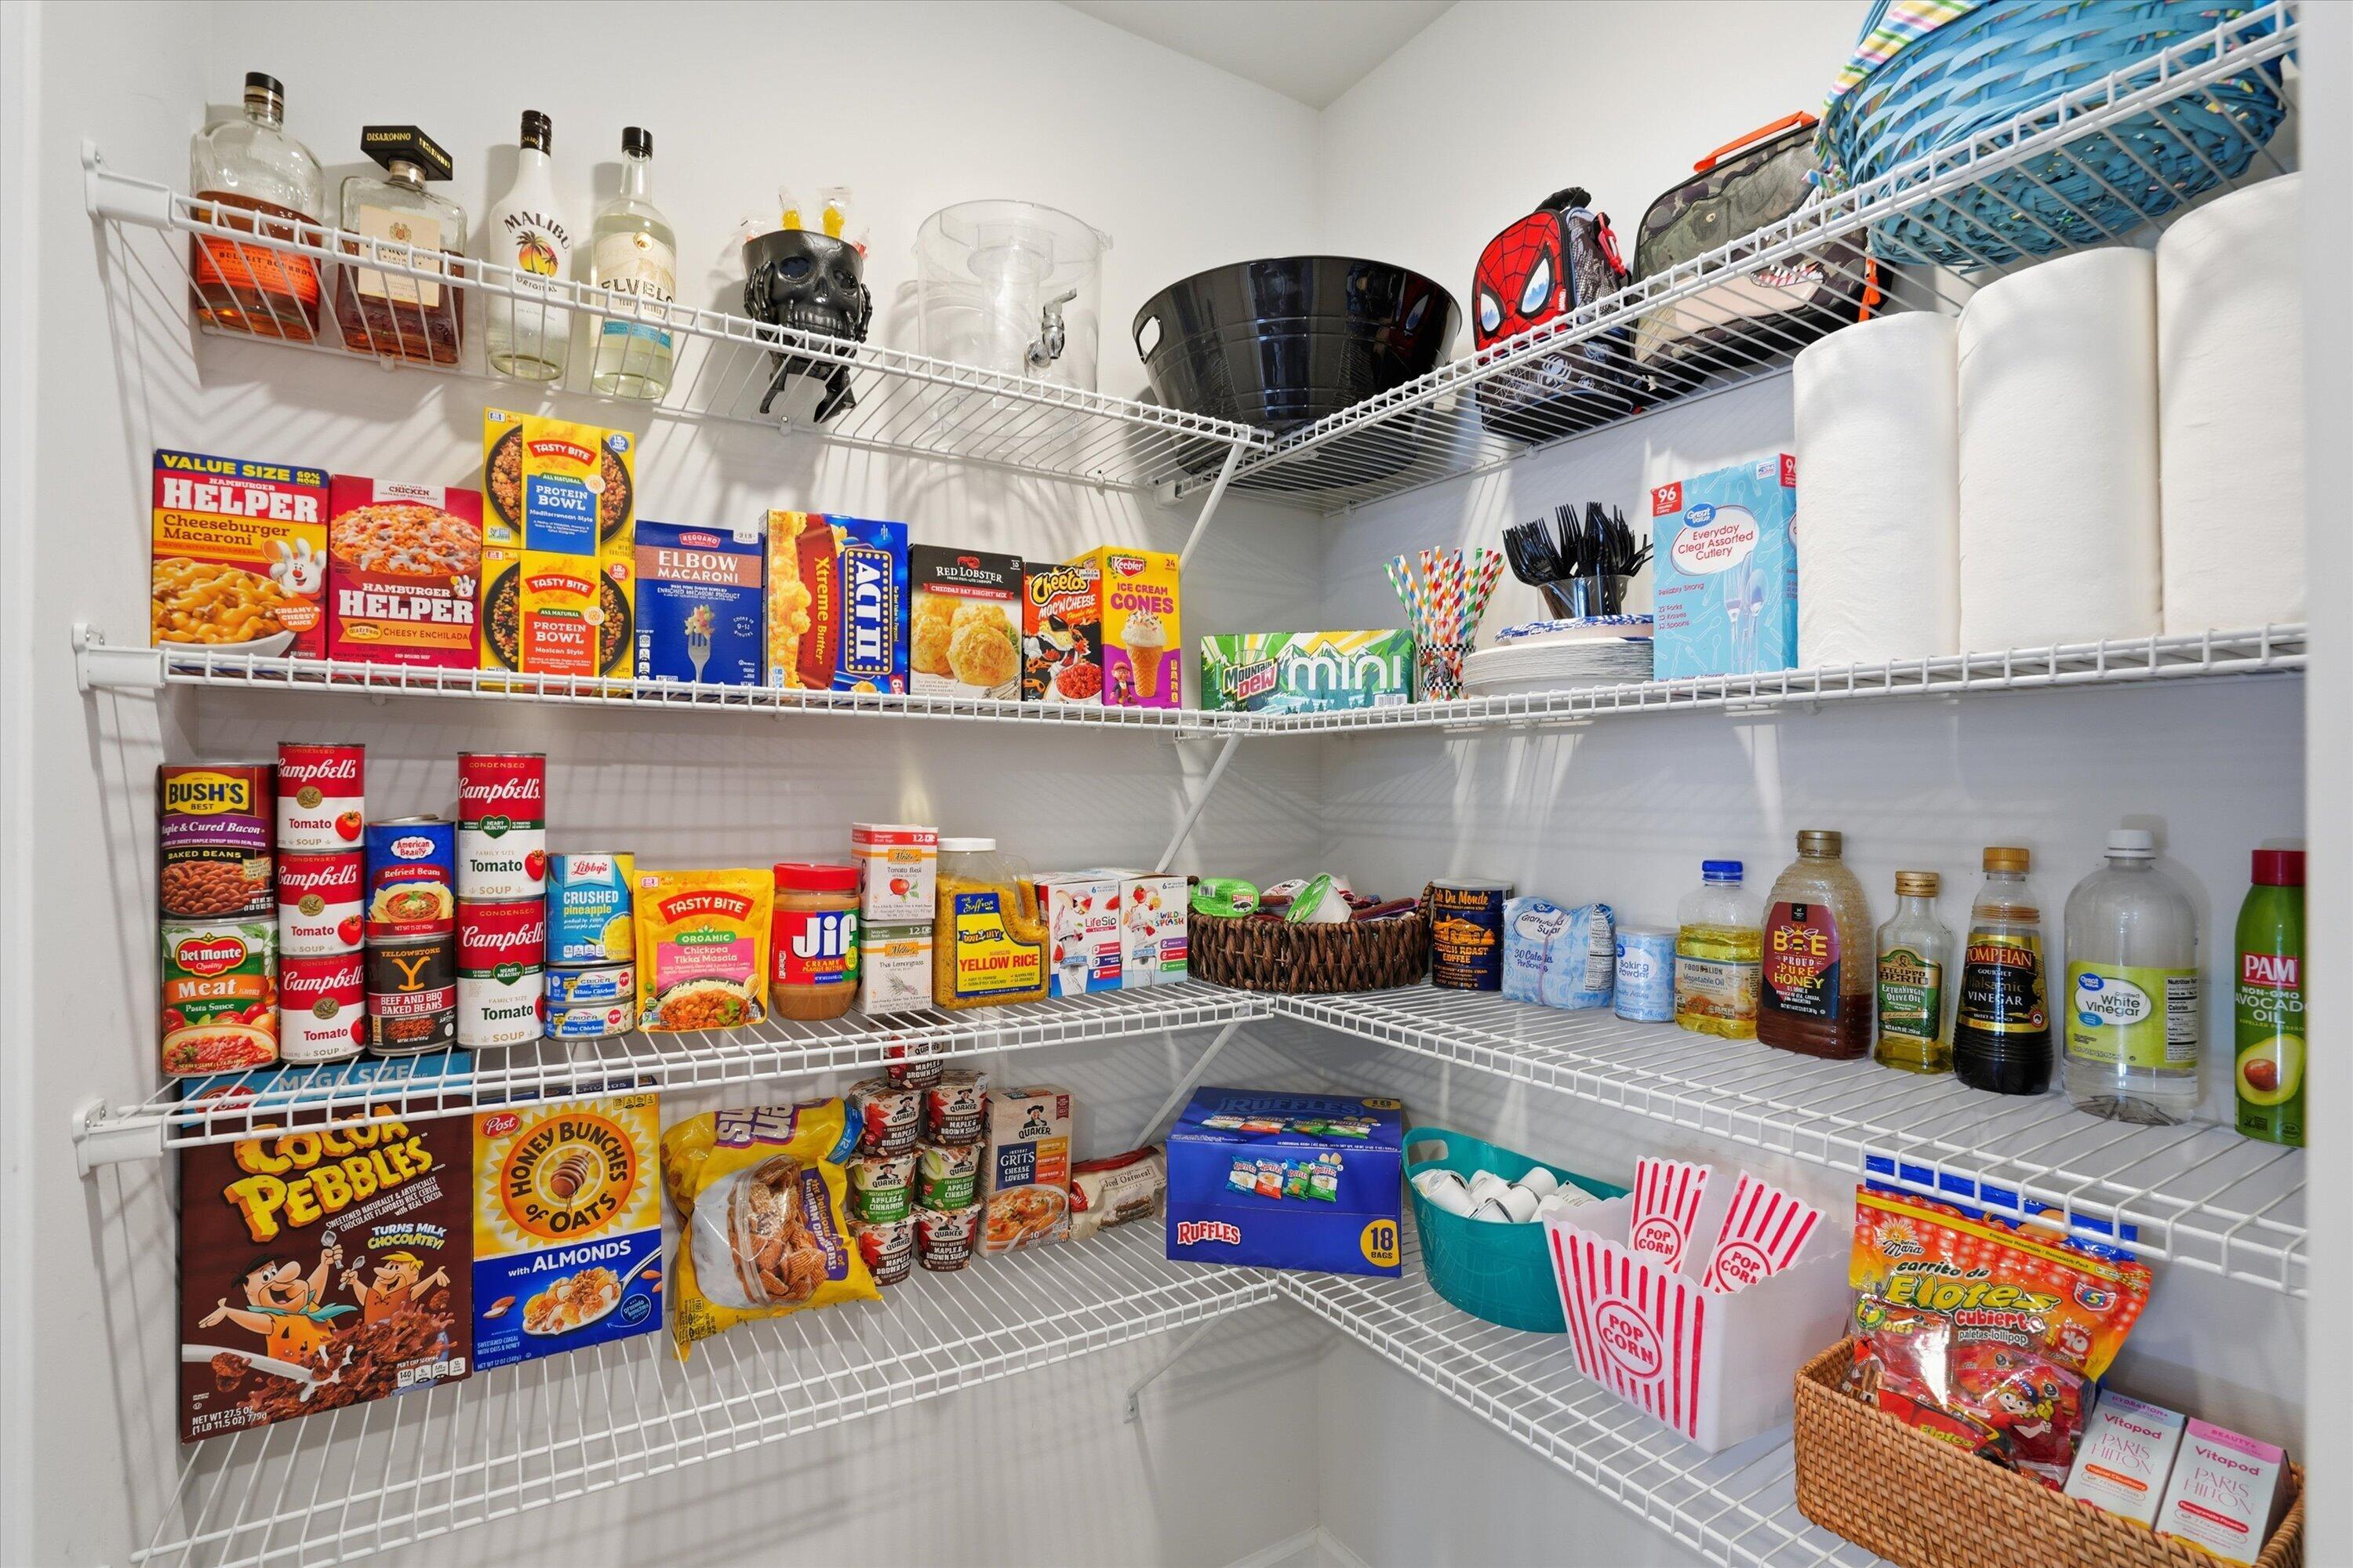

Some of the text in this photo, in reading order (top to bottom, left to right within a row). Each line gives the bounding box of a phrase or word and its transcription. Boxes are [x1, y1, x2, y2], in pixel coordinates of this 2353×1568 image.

[366, 133, 411, 142] DISARONNO
[504, 210, 571, 250] MALIBU
[533, 444, 591, 460] TASTY BITE
[162, 454, 290, 481] VALUE SIZE
[209, 477, 275, 492] HAMBURGER
[162, 477, 318, 522] HELPER
[536, 486, 588, 500] PROTEIN
[1657, 488, 1676, 502] 96
[538, 495, 586, 511] BOWL
[163, 515, 290, 538] Cheeseburger
[1693, 523, 1740, 540] Everyday
[163, 527, 253, 546] Macaroni
[1678, 531, 1754, 555] Clear Assorted
[659, 550, 738, 572] ELBOW
[1696, 547, 1733, 562] Cutlery
[1112, 558, 1144, 573] Keebler
[657, 567, 739, 584] MACARONI
[936, 566, 958, 577] RED
[958, 566, 1004, 584] LOBSTER
[362, 583, 451, 598] HAMBURGER
[532, 578, 590, 593] TASTY BITE
[814, 555, 830, 621] Xtreme
[856, 561, 882, 622] ACT
[1031, 569, 1088, 605] Cheetos
[1117, 582, 1168, 595] ICE CREAM
[338, 590, 474, 624] HELPER
[1111, 593, 1174, 614] CONES
[533, 621, 587, 632] PROTEIN
[384, 628, 416, 638] CHEESY
[420, 630, 468, 641] ENCHILADA
[536, 631, 584, 644] BOWL
[1288, 655, 1401, 690] mini
[278, 759, 356, 782] Campbell's
[169, 784, 244, 805] BUSH'S
[459, 778, 540, 804] Campbell's
[189, 821, 260, 835] Cured Bacon
[289, 818, 332, 829] Tomato
[396, 840, 430, 849] American
[168, 850, 198, 860] BAKED
[470, 859, 522, 872] Tomato
[571, 860, 607, 875] Libby's
[278, 864, 357, 891] Campbell's
[384, 868, 440, 879] Refried Beans
[479, 886, 511, 895] SOUP
[563, 890, 619, 904] CRUSHED
[1459, 890, 1489, 905] Monde
[564, 904, 612, 917] pineapple
[667, 897, 747, 915] TASTY BITE
[291, 926, 335, 937] Tomato
[682, 933, 730, 943] ORGANIC
[792, 912, 857, 958] Jif
[180, 948, 242, 962] Del Monte
[381, 947, 441, 958] YELLOWSTONE
[683, 945, 728, 955] Chickpea
[674, 954, 737, 963] Tikka Masala
[959, 954, 1038, 973] YELLOW RICE
[1783, 955, 1814, 966] PROUD
[1780, 962, 1815, 977] PURE
[1882, 966, 1926, 977] FILIPPO
[2245, 955, 2295, 983] PAM
[1774, 972, 1825, 989] HONEY
[178, 979, 238, 999] Meat
[2242, 985, 2300, 999] NON-GMO
[381, 994, 424, 1006] BEEF AND
[1886, 992, 1907, 1002] OLIVE
[1968, 991, 2023, 1006] VINEAR
[2100, 995, 2140, 1008] White
[209, 1002, 235, 1011] Sauce
[382, 1001, 442, 1015] BAKED BEANS
[482, 1005, 533, 1020] Tomato
[2086, 1001, 2140, 1017] Vinegar
[2253, 1009, 2286, 1024] OIL
[304, 1028, 348, 1041] Tomato
[493, 1031, 525, 1042] SOUP
[314, 1047, 340, 1057] SOUP
[358, 1064, 410, 1084] SIZE
[950, 1104, 977, 1112] QUAKER
[1218, 1097, 1366, 1116] RUFFLES
[486, 1116, 515, 1133] Post
[892, 1111, 916, 1123] QUAKER
[1019, 1126, 1051, 1139] QUAKER
[511, 1121, 628, 1199] HONEY BUNCHES
[1000, 1151, 1035, 1166] GRITS
[1005, 1166, 1030, 1174] CHEESE
[1005, 1173, 1029, 1182] LOVERS
[224, 1136, 433, 1242] PEBBLES
[872, 1178, 902, 1188] QUAKER
[325, 1195, 394, 1230] SWEETENED NATURALLY
[340, 1199, 405, 1232] CHOCOLATE FLAVORED
[526, 1191, 616, 1233] of OATS
[372, 1223, 447, 1237] TURNS MILK
[934, 1230, 963, 1239] QUAKER
[1178, 1222, 1240, 1244] RUFFLES
[1646, 1228, 1671, 1241] POP
[367, 1233, 446, 1250] CHOCOLATEY!
[886, 1238, 911, 1251] QUAKER
[1371, 1228, 1393, 1250] 18
[1638, 1238, 1675, 1255] CORN
[508, 1240, 631, 1277] with ALMONDS
[1730, 1251, 1760, 1273] POP
[1721, 1260, 1759, 1285] CORN
[1897, 1261, 1990, 1278] carrito de
[1884, 1274, 2063, 1312] Elotes
[1609, 1314, 1644, 1341] POP
[1958, 1329, 2028, 1346] paletas-lollipop
[1602, 1327, 1654, 1366] CORN
[192, 1407, 242, 1425] NET WT 27.5
[214, 1418, 231, 1429] 11.5
[2104, 1413, 2162, 1440] Vitapod
[2101, 1433, 2150, 1460] PARIS
[2092, 1442, 2155, 1475] HILTON
[2196, 1446, 2260, 1476] Vitapod
[2195, 1468, 2249, 1498] PARIS
[2184, 1479, 2253, 1515] HILTON
